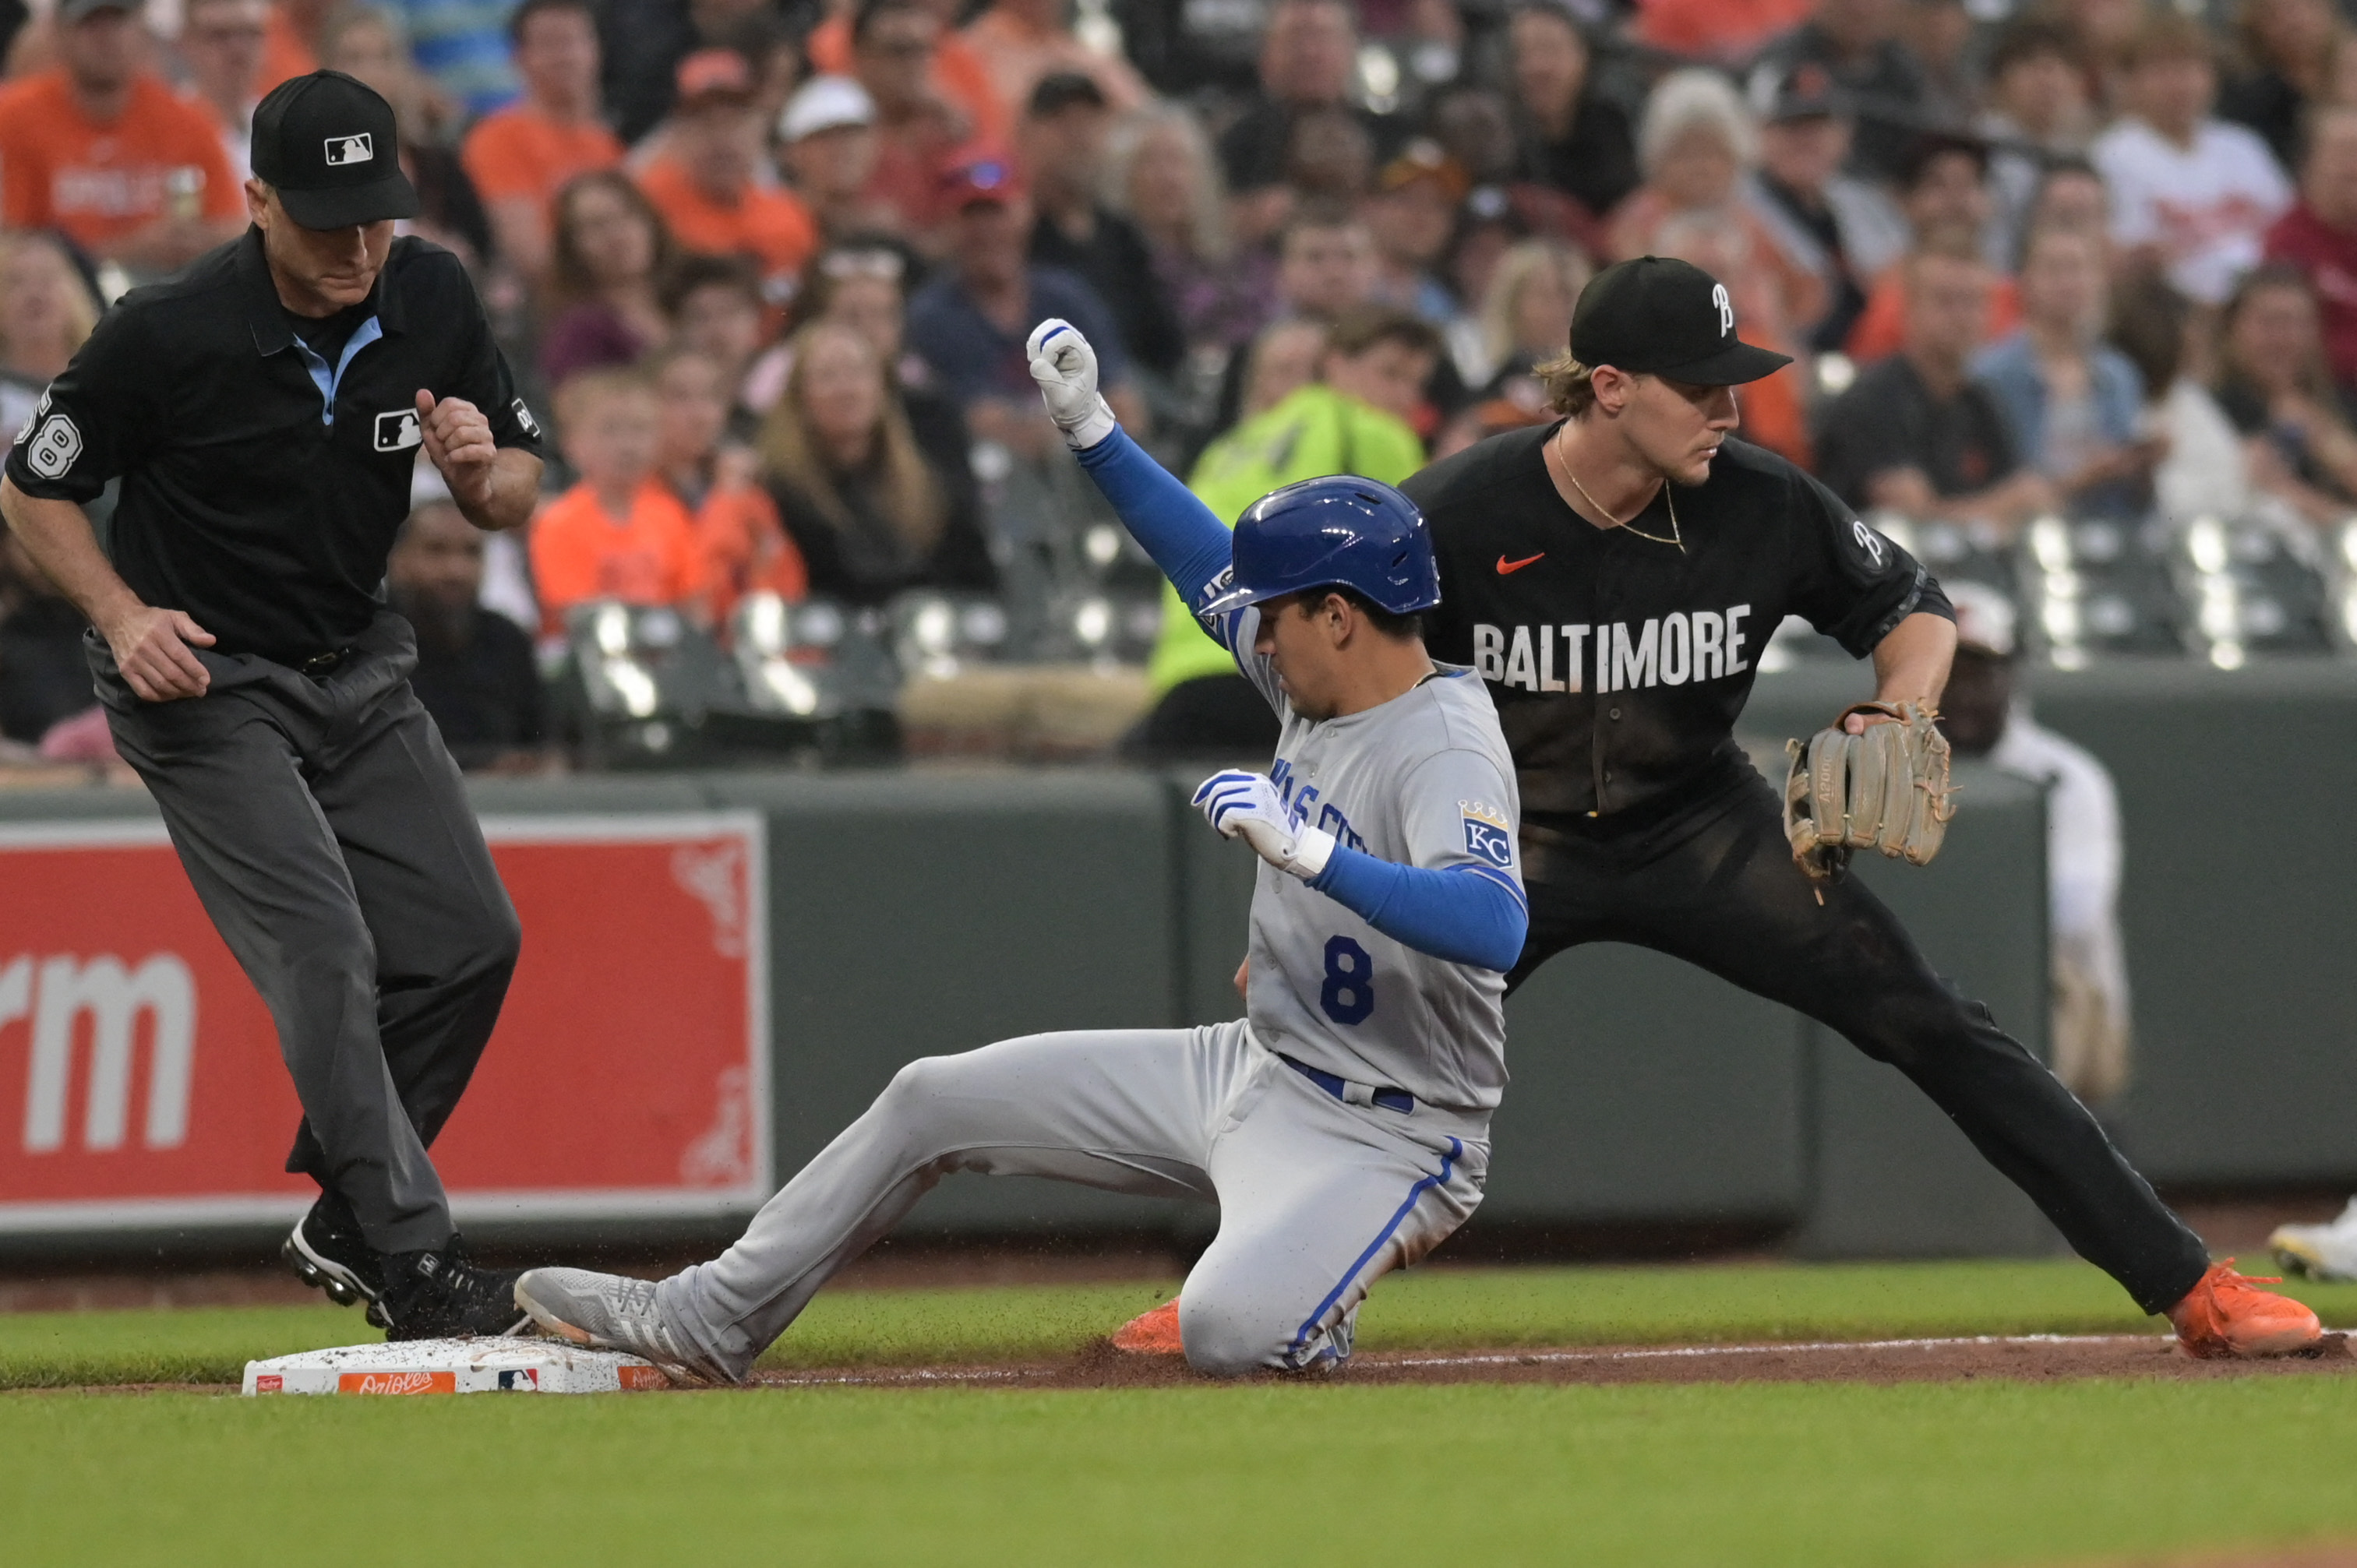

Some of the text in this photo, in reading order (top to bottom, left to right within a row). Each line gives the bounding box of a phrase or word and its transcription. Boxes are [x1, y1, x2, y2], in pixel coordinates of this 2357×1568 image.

[1712, 284, 1734, 338] B
[1853, 520, 1882, 566] B
[1473, 604, 1751, 694] BALTIMORE
[1466, 823, 1509, 864] KC
[1320, 935, 1374, 1026] 8
[358, 1372, 432, 1394] Orioles
